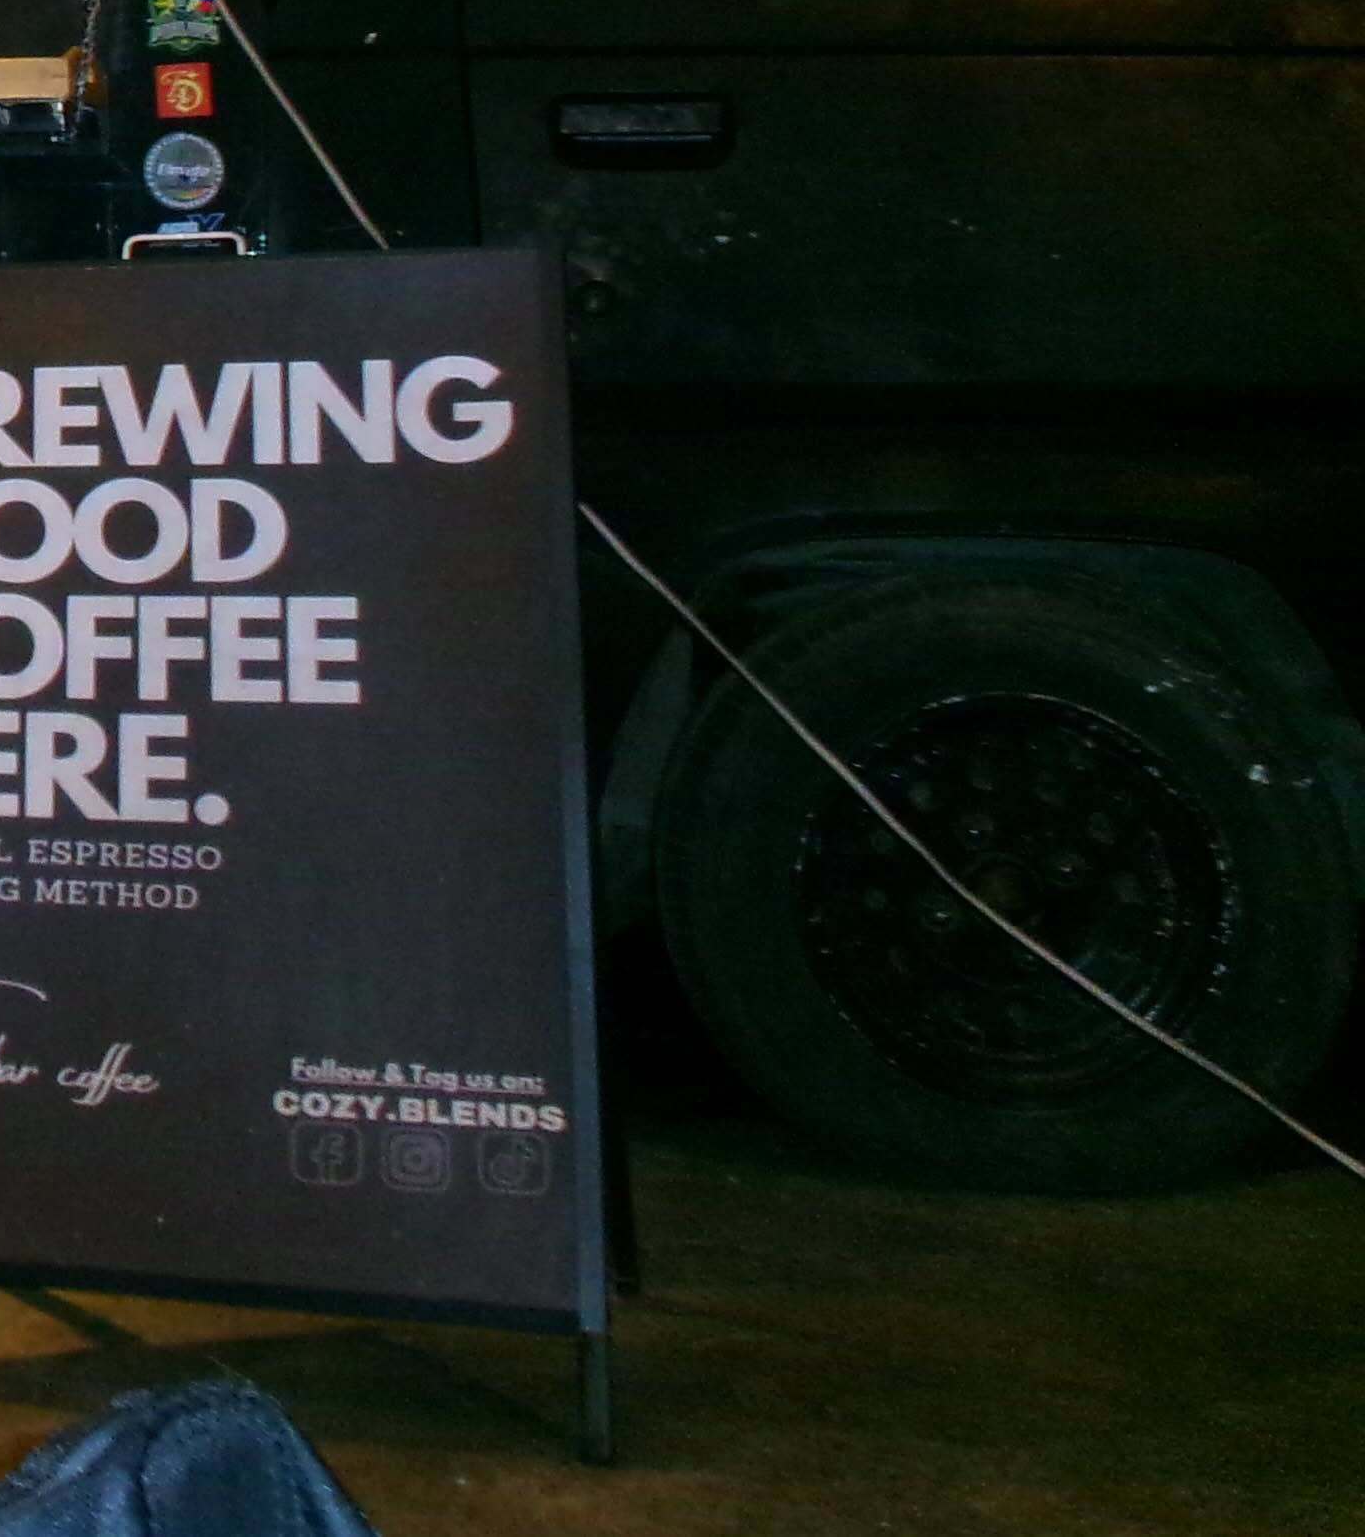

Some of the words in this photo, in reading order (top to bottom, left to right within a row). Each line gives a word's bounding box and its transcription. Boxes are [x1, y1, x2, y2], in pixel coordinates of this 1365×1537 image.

[27, 838, 223, 871] ESPRESSO
[33, 877, 200, 910] METHOD
[56, 1042, 160, 1106] coffee
[290, 1056, 377, 1083] Follow
[383, 1061, 406, 1084] &
[408, 1063, 460, 1092] Tag
[464, 1073, 494, 1089] us
[272, 1089, 567, 1133] COZY.BLENDS
